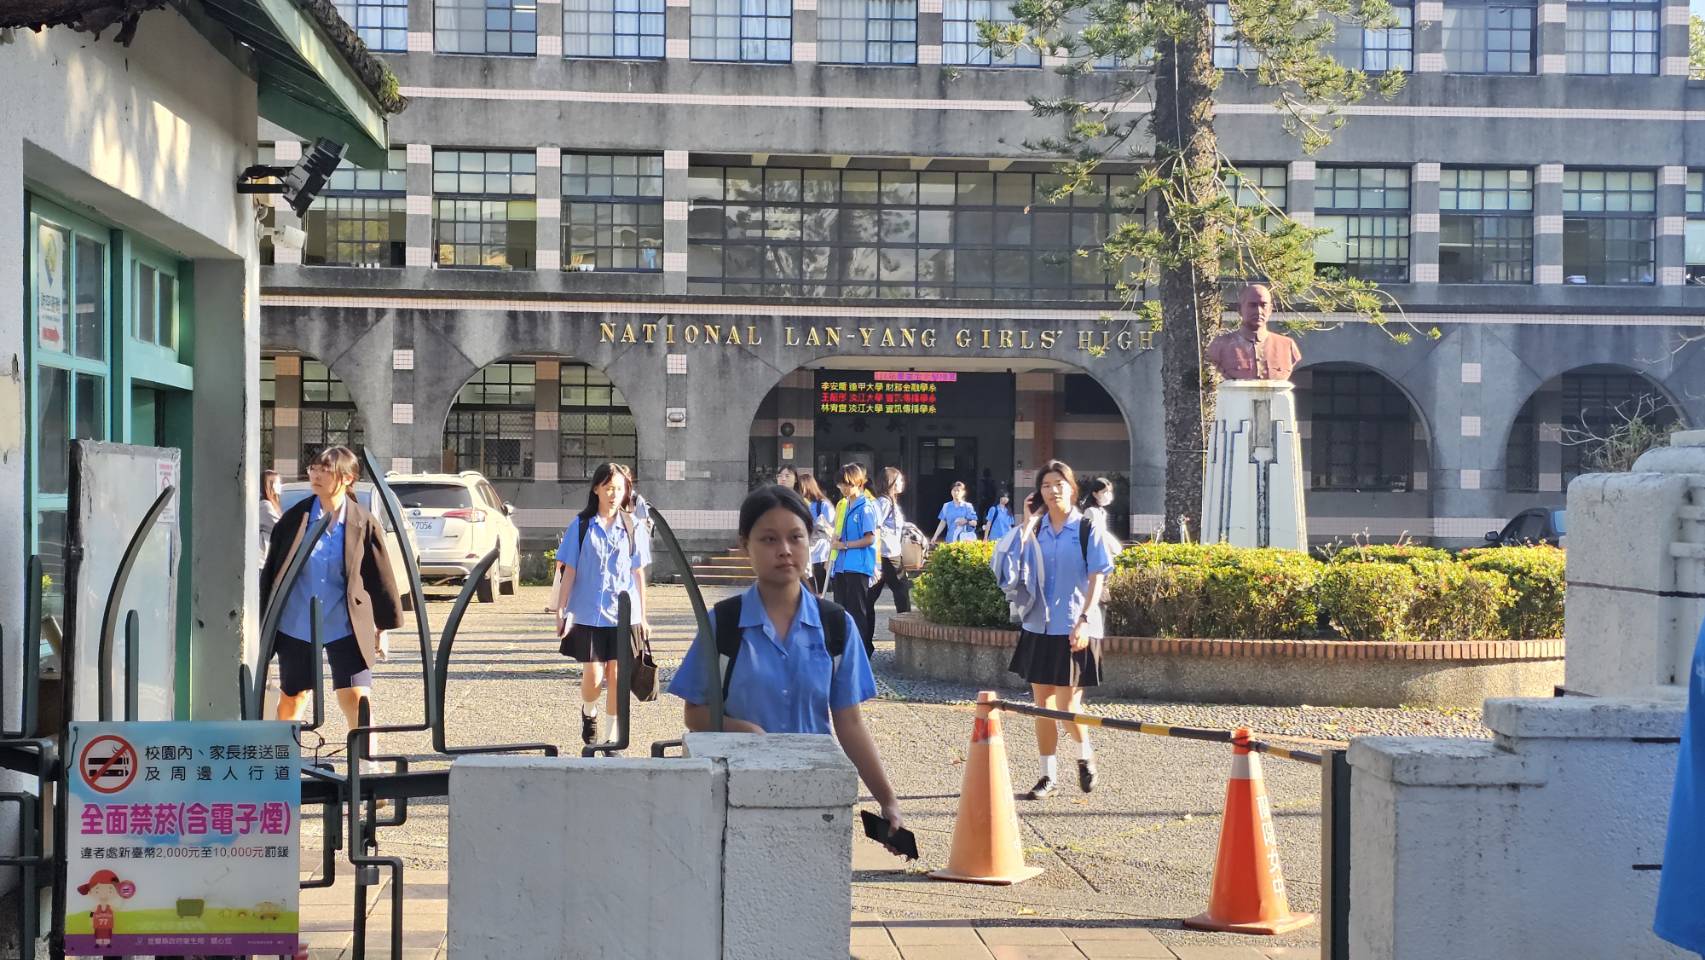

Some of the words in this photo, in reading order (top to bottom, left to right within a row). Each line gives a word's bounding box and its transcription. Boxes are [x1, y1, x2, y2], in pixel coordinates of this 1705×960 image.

[600, 322, 762, 345] NATIONAL
[785, 326, 936, 347] LAN-YANG
[1078, 331, 1154, 350] HIGH
[145, 745, 290, 760] 校園內、家長接送區
[145, 766, 290, 781] 及周邊人行道
